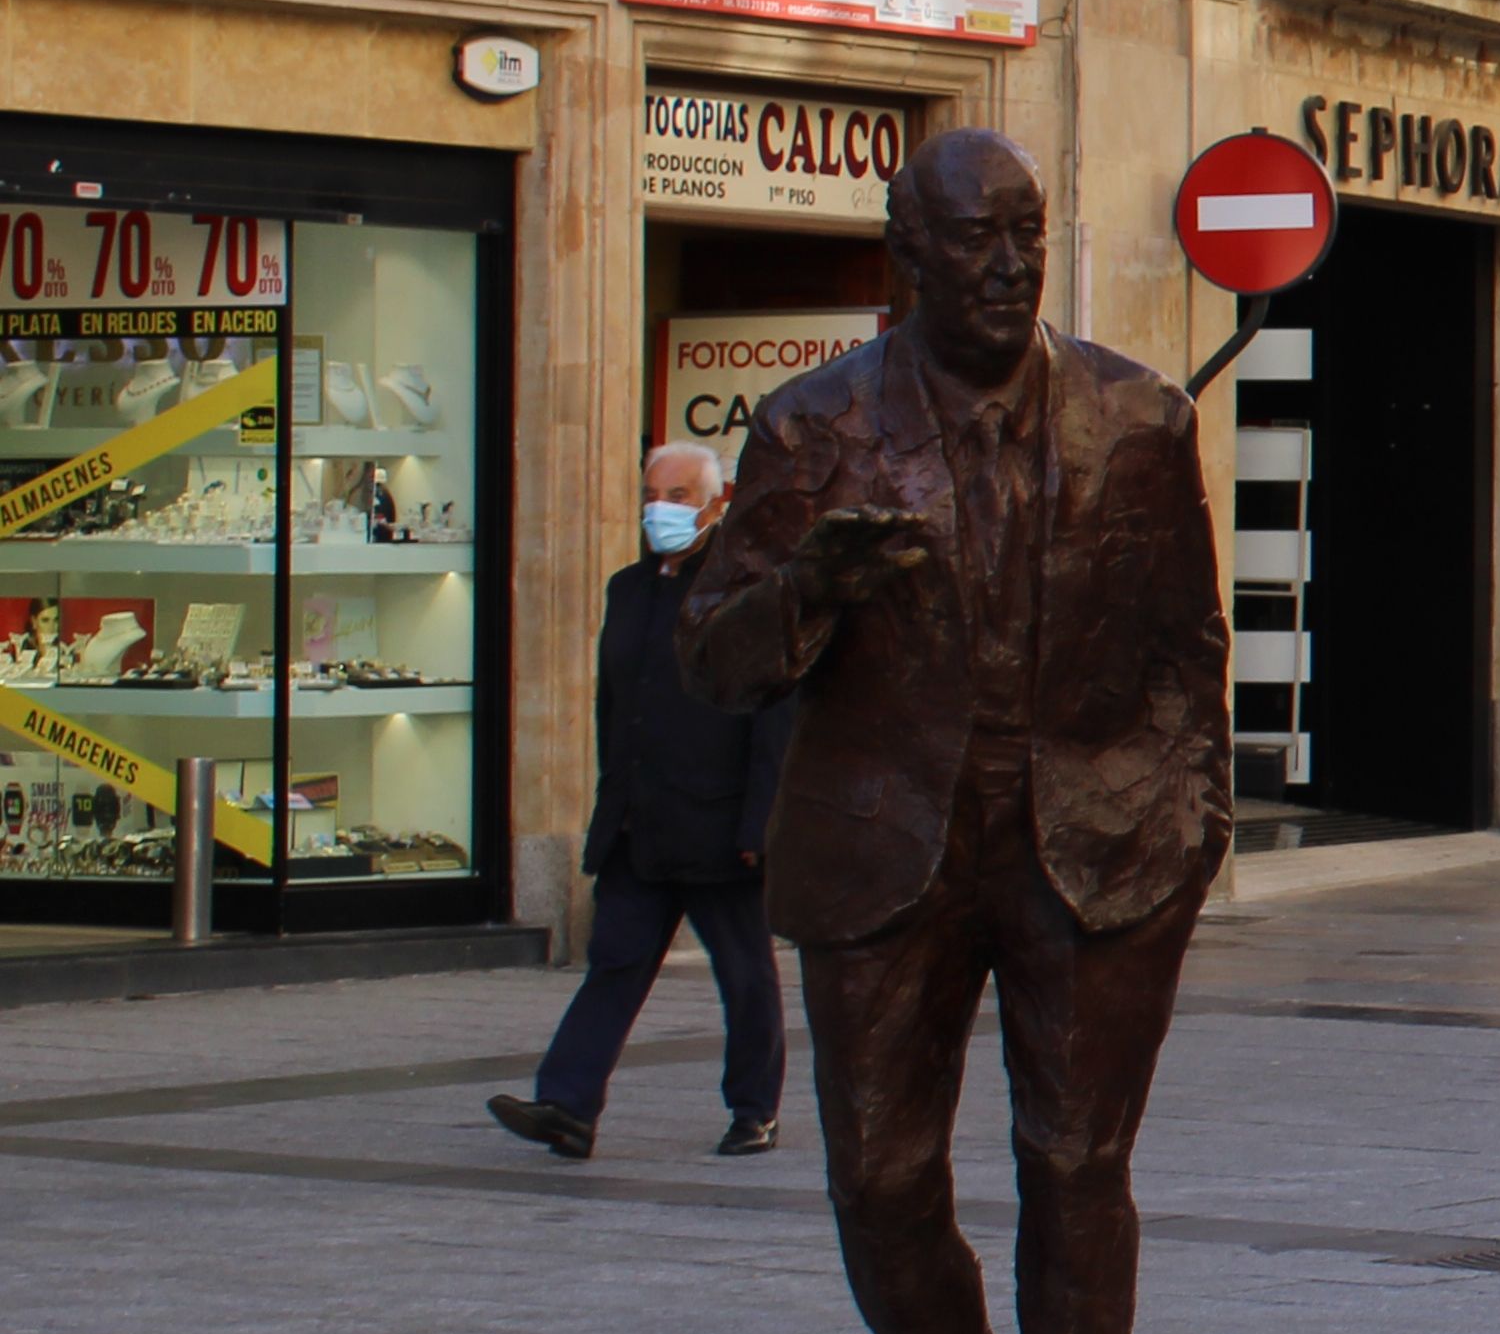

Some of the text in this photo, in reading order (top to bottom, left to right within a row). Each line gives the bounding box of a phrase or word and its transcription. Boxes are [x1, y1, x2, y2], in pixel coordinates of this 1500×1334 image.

[643, 154, 744, 177] RODUCCIÓN
[758, 102, 900, 182] CALCO
[662, 178, 726, 199] PLANOS
[788, 188, 816, 206] PISO
[86, 210, 151, 299] 70
[191, 216, 259, 298] 70
[44, 278, 282, 299] DTO DTO DTO
[9, 310, 278, 336] PLATA EN RELOJES EN ACERO
[1, 451, 114, 529] ALMACENES
[24, 710, 140, 786] ALMACENES
